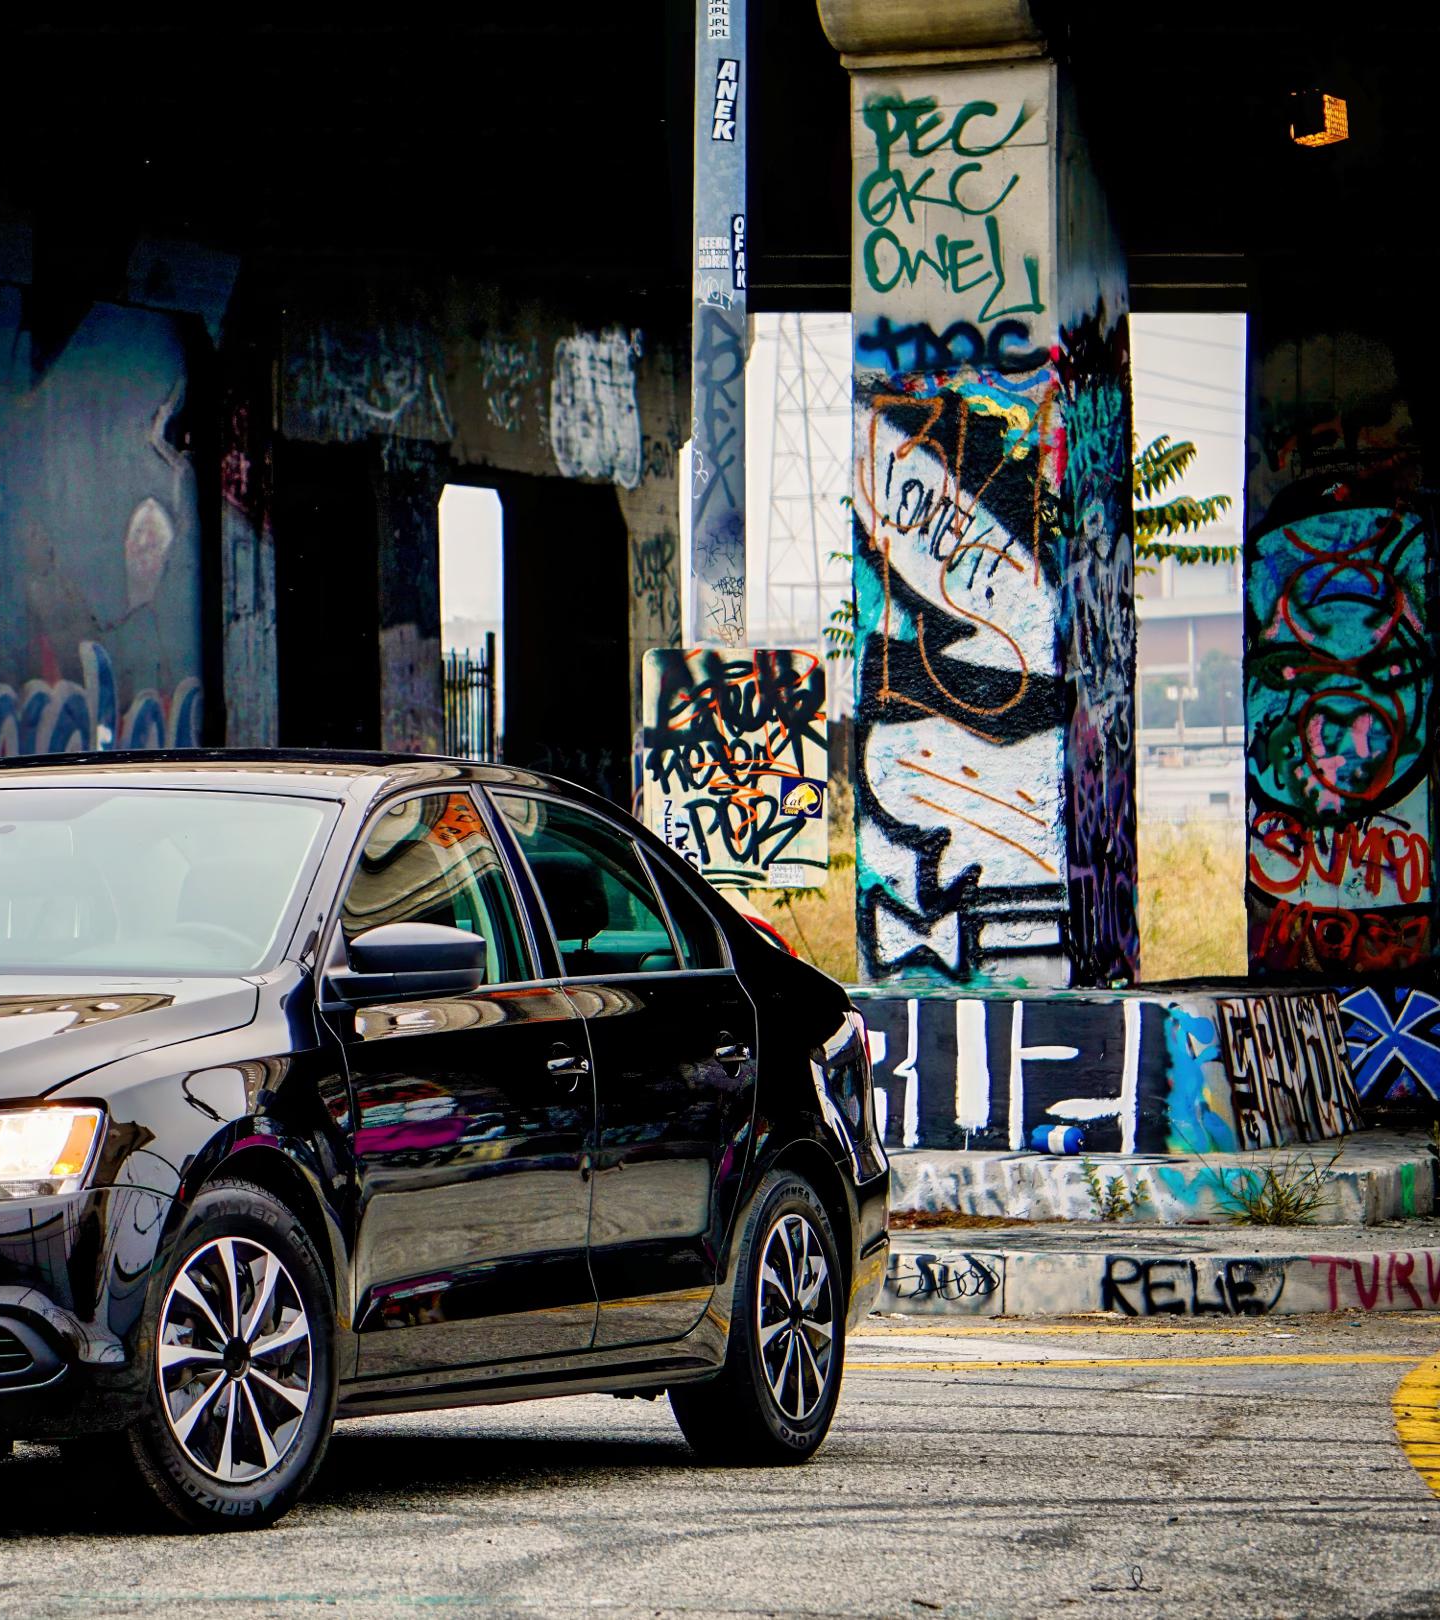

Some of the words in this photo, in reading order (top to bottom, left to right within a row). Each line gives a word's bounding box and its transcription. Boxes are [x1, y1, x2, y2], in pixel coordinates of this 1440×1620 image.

[709, 7, 728, 15] JPL
[709, 18, 728, 27] JPL
[709, 29, 728, 37] JPL
[712, 60, 738, 140] ANEK
[1310, 1250, 1440, 1312] TUR
